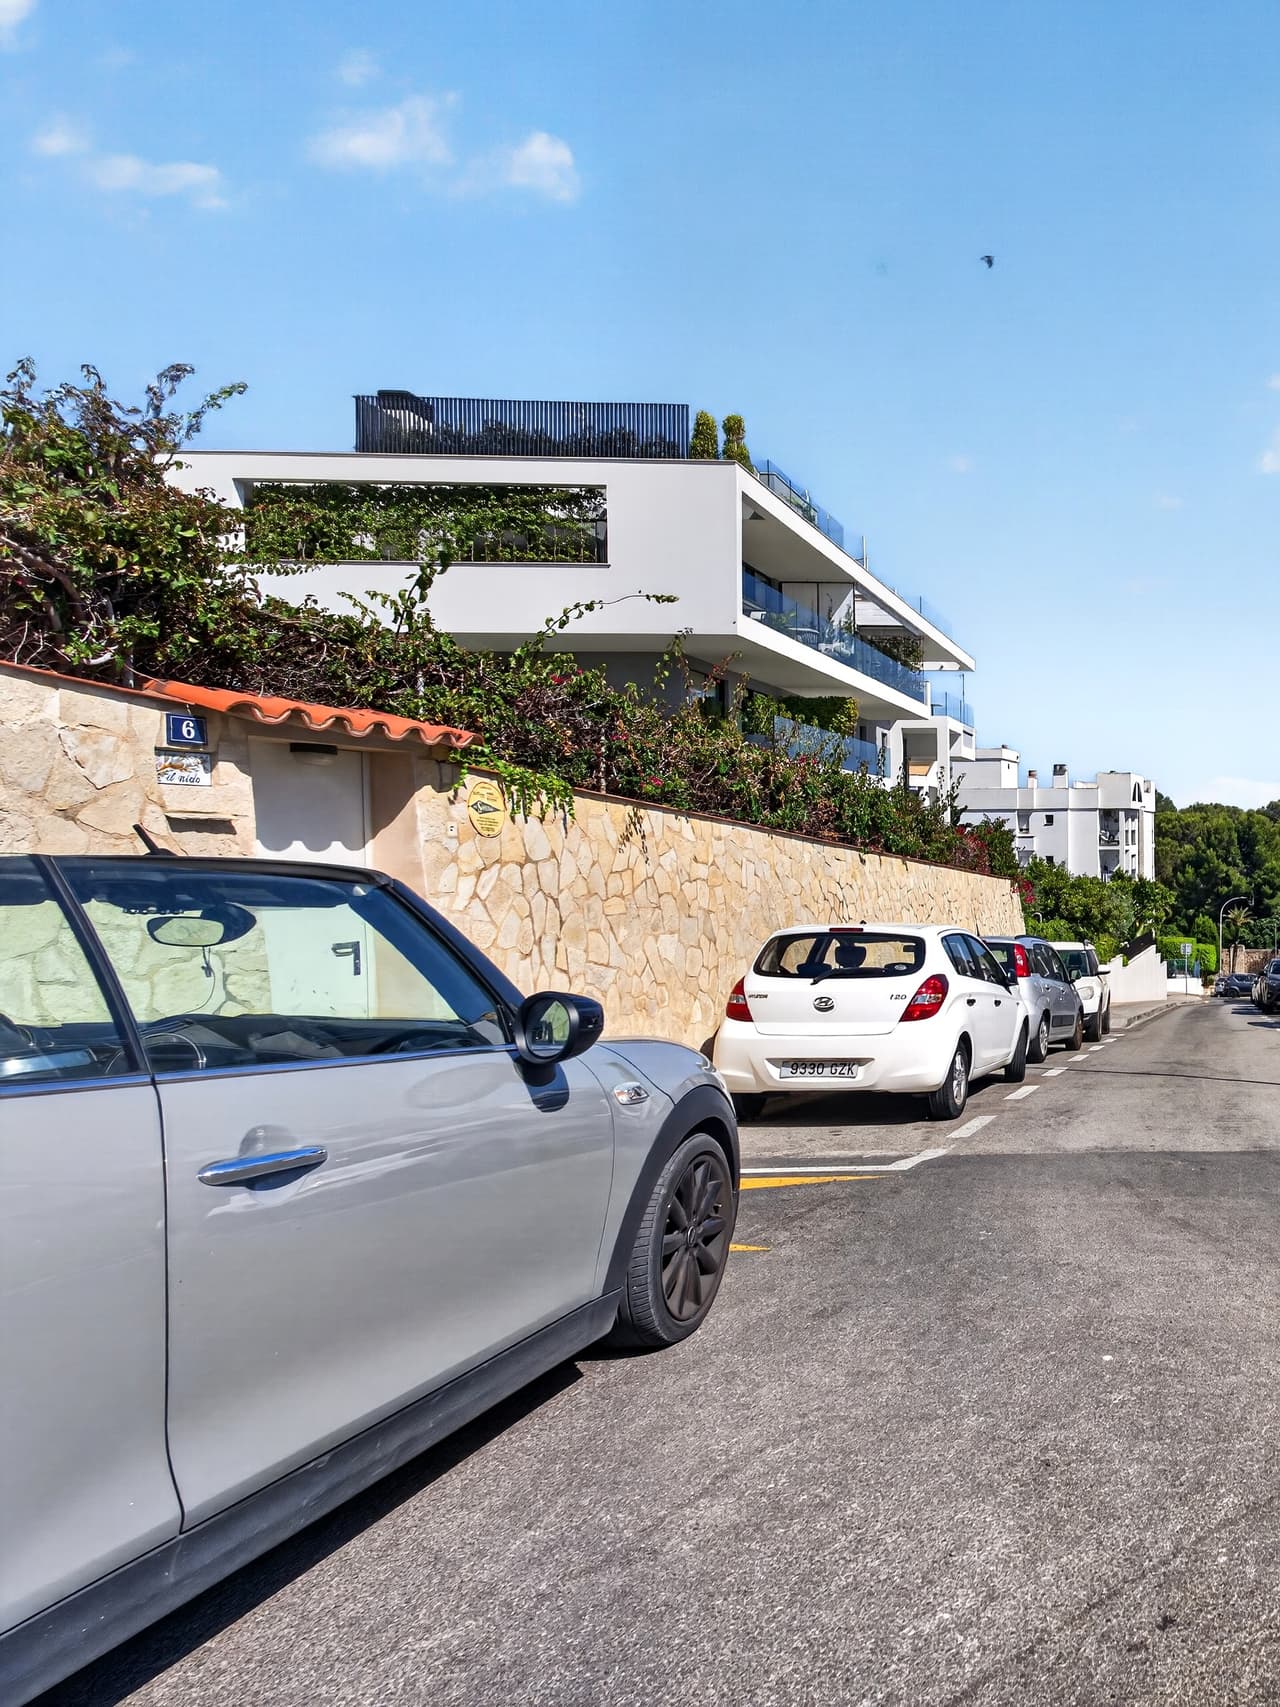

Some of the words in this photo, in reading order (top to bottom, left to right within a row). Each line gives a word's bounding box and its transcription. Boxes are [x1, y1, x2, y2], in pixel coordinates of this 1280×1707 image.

[182, 720, 195, 739] 6
[790, 1062, 825, 1075] 9330
[830, 1063, 854, 1075] GZK
